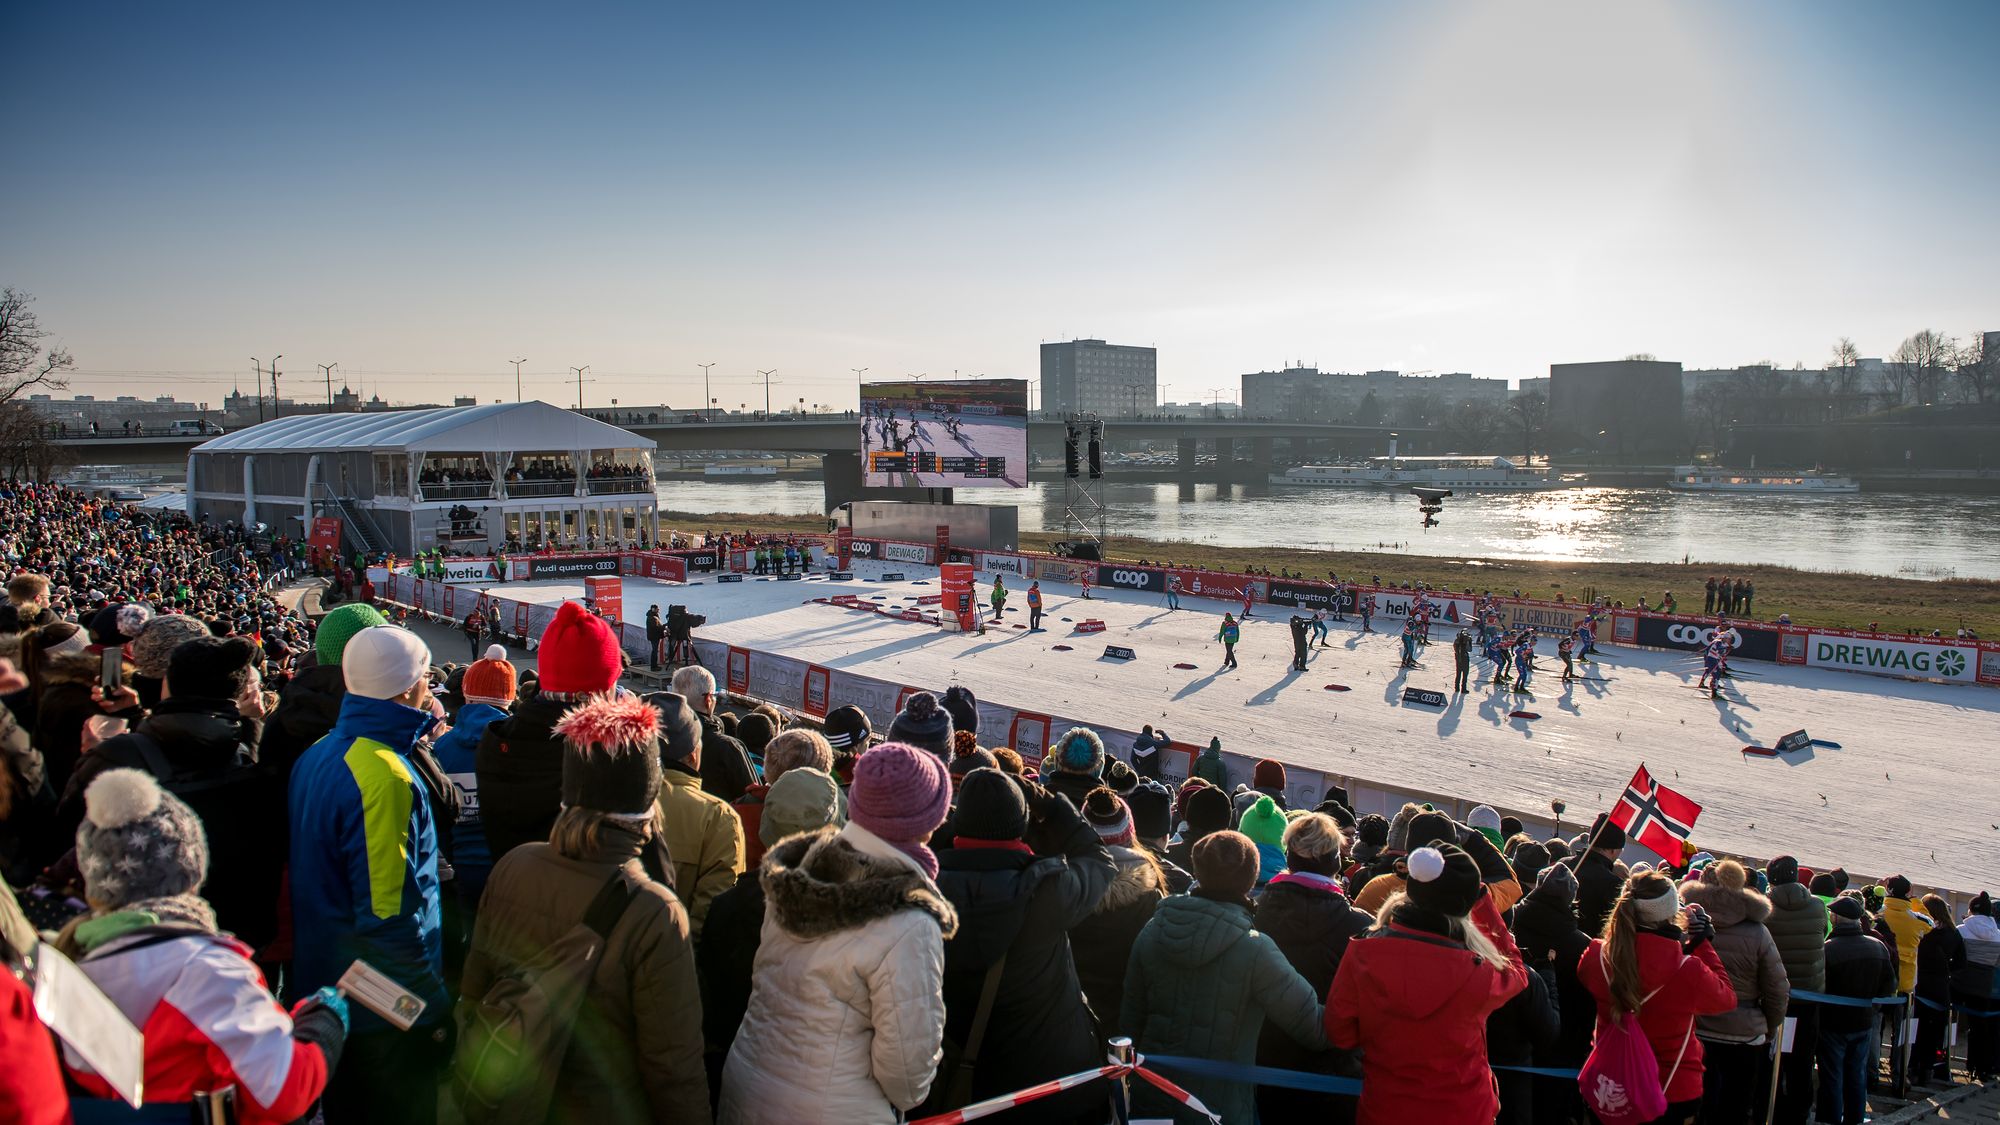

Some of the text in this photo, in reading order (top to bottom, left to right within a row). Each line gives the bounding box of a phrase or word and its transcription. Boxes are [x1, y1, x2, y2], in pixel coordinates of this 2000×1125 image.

[852, 542, 871, 554] coop
[888, 547, 916, 560] DREWAG
[535, 562, 593, 574] Audi quattro
[987, 559, 1015, 572] helvetia
[427, 567, 482, 580] hlvetia
[1112, 570, 1149, 588] coop
[1203, 586, 1235, 596] Sparkasse
[1272, 589, 1328, 603] Audi quattro
[1386, 600, 1440, 618] helia
[1513, 608, 1574, 627] LE GRUYÈRE
[1817, 642, 1930, 672] DREWAG
[752, 661, 802, 689] NORDIC
[1018, 740, 1040, 751] NORDIC
